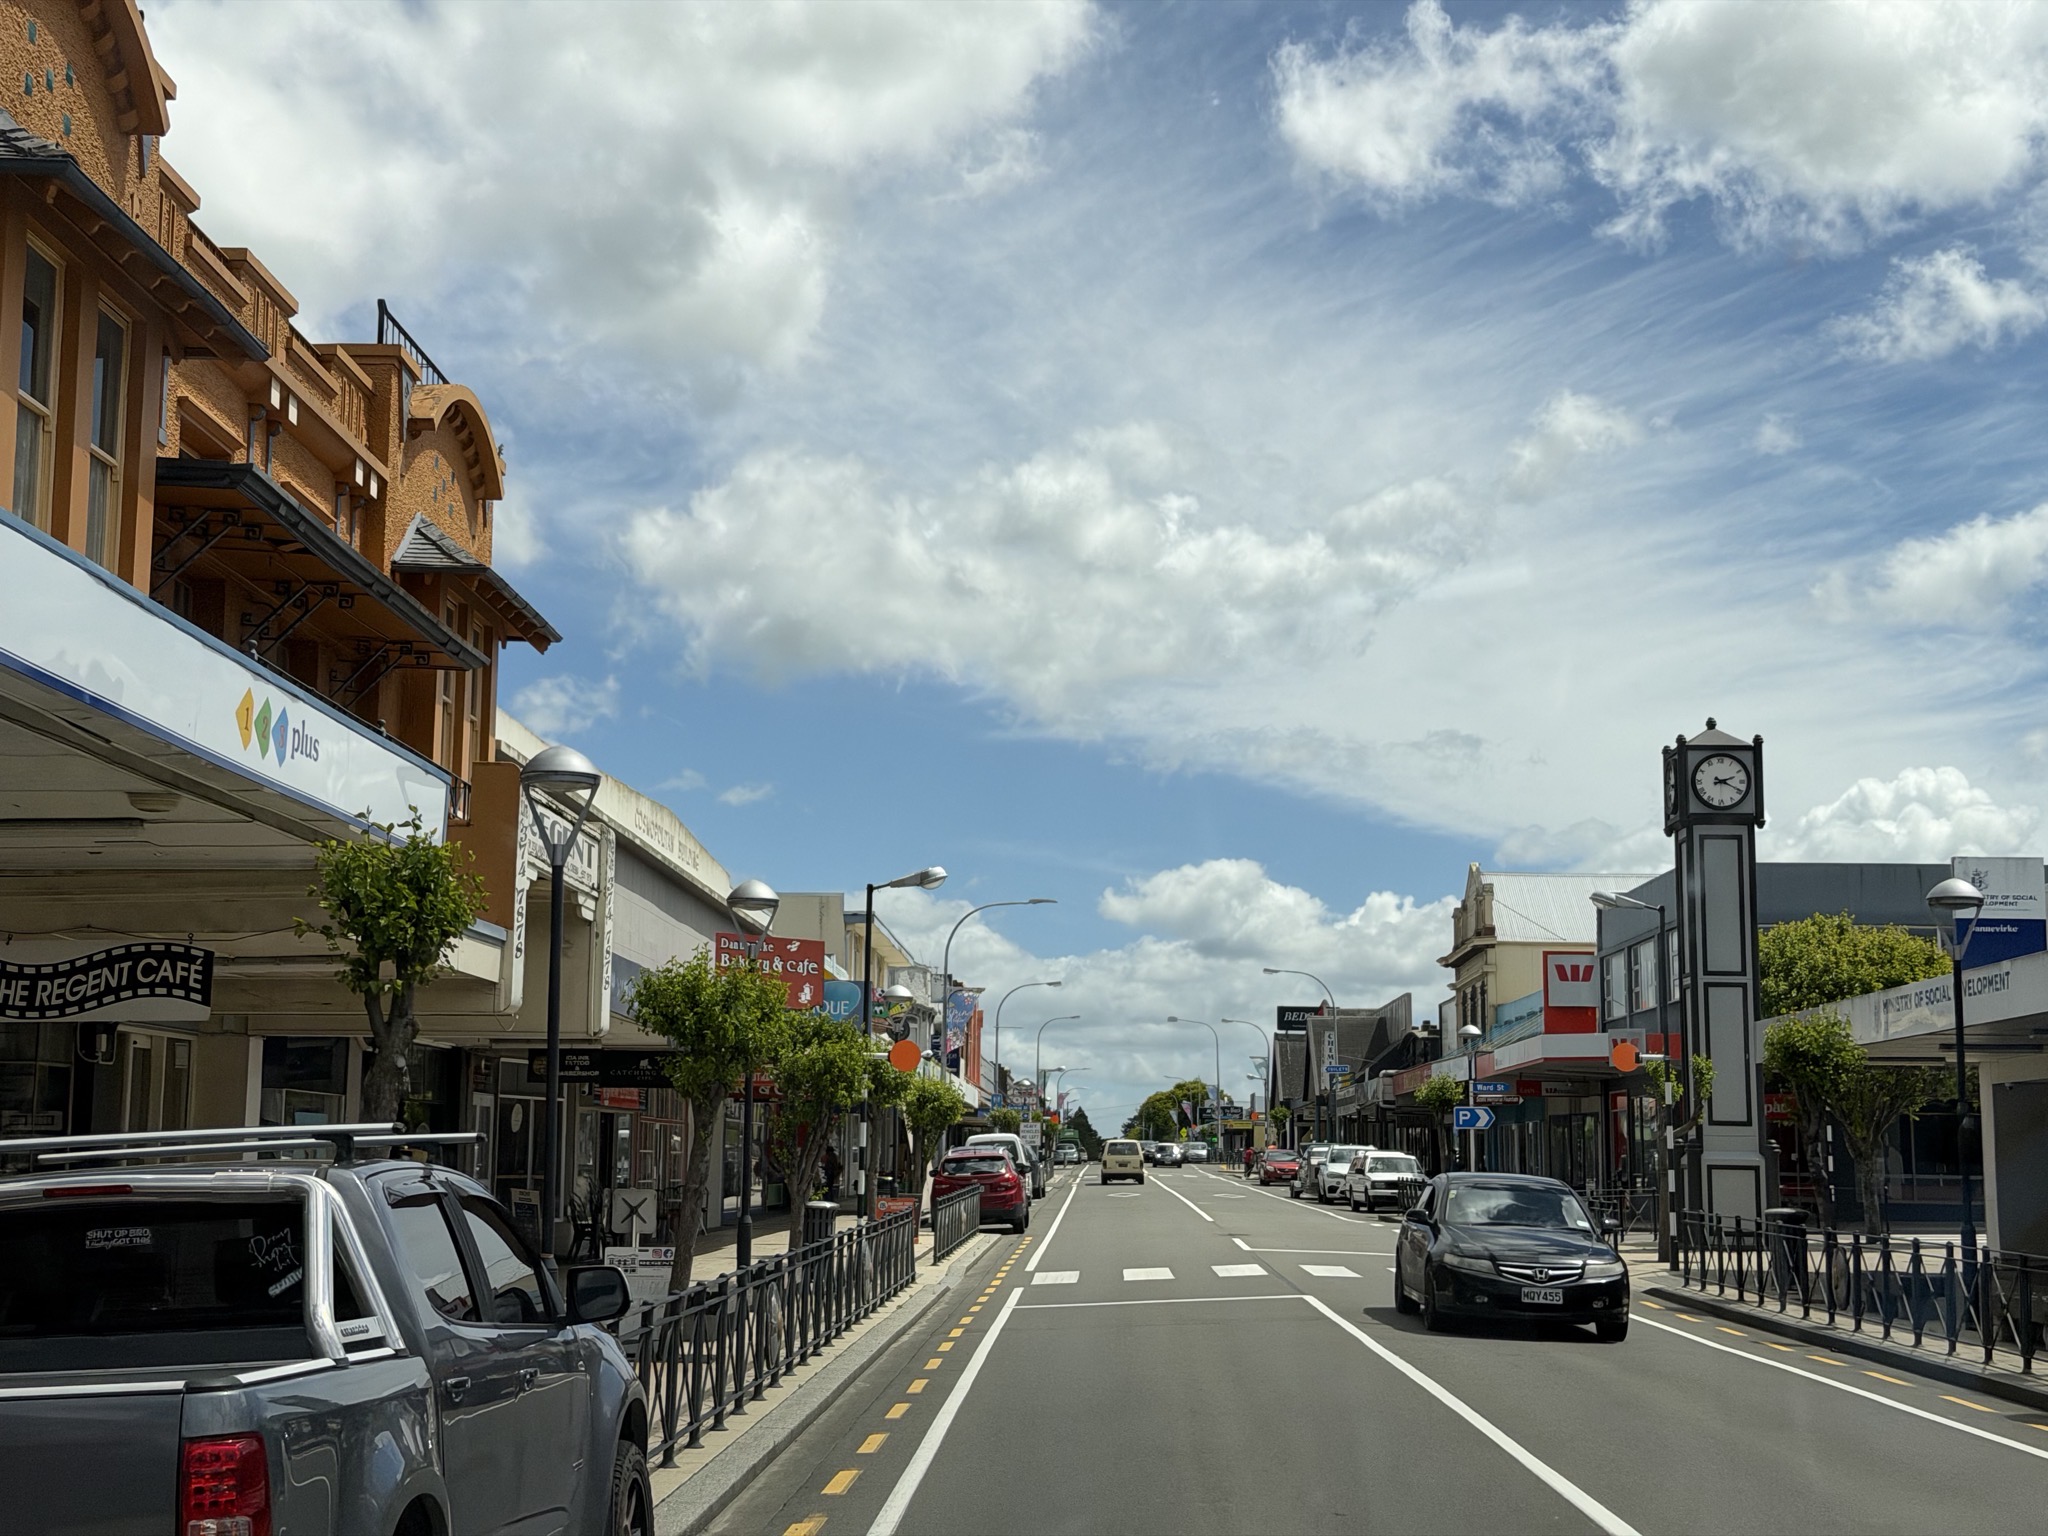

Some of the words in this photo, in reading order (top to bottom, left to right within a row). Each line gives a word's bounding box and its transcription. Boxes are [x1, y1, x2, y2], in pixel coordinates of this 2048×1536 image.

[290, 719, 320, 762] plus
[1973, 924, 2019, 933] annevirke
[0, 979, 30, 1007] HE
[35, 961, 133, 1007] REGENT
[136, 957, 204, 989] CAFÉ
[1914, 990, 1924, 1009] OF
[1925, 984, 1952, 1006] SOCIAL
[1962, 971, 2011, 998] VELOPMENT
[1476, 1083, 1494, 1091] Ward
[1496, 1083, 1505, 1091] St
[1459, 1110, 1471, 1125] P
[86, 1230, 112, 1239] SHUT
[114, 1229, 128, 1238] UP
